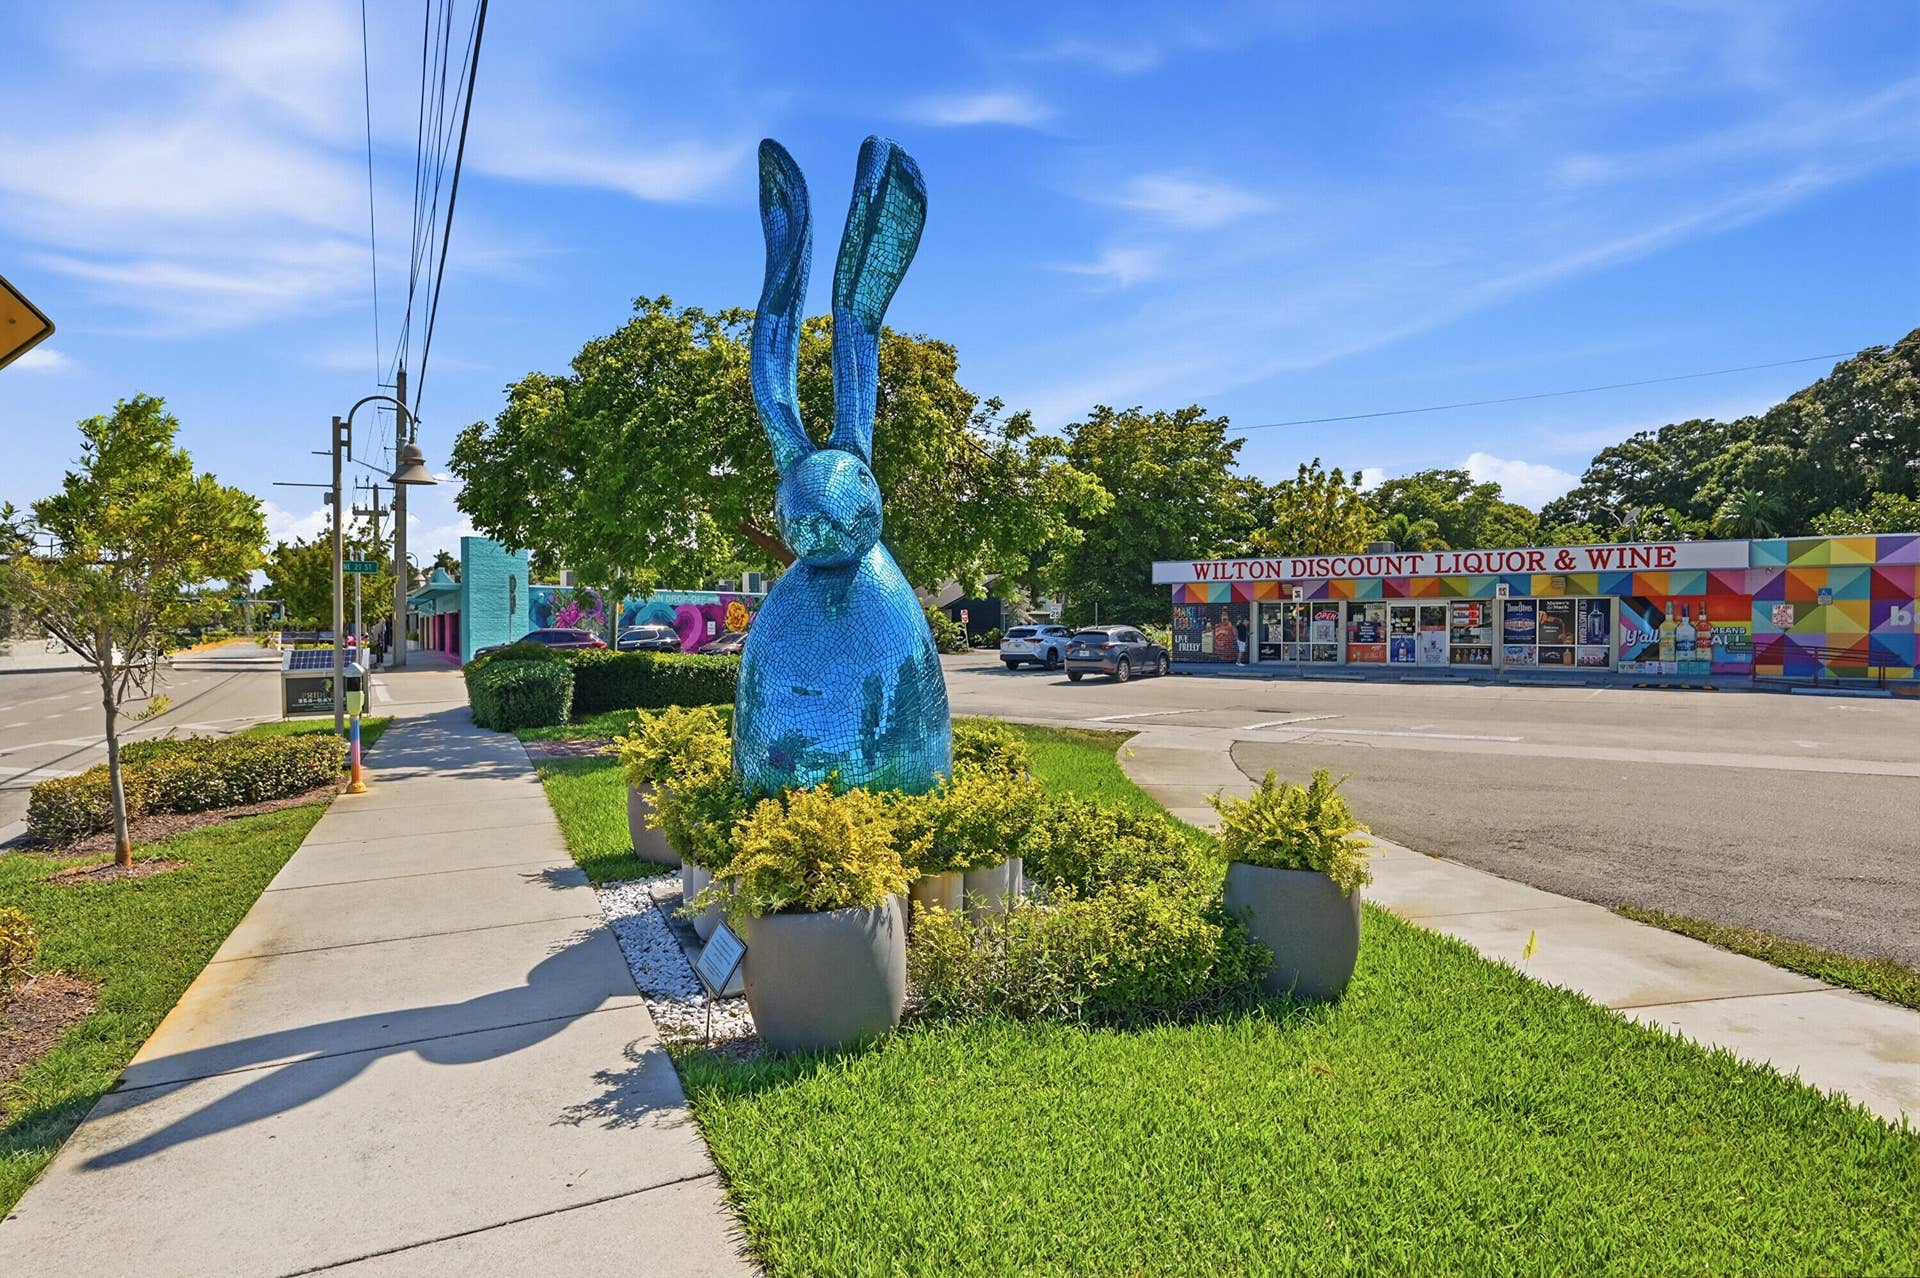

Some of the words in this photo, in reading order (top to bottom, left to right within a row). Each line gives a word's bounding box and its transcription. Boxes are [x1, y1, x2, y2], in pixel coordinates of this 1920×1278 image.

[1192, 560, 1283, 581] WILTON
[1291, 555, 1425, 578] DISCOUNT
[1434, 550, 1547, 574] LIQUOR
[1554, 549, 1577, 571] &
[1585, 545, 1677, 570] WINE
[1315, 611, 1336, 620] OPEN
[1710, 627, 1747, 635] MEANS
[1179, 643, 1201, 652] FREELY
